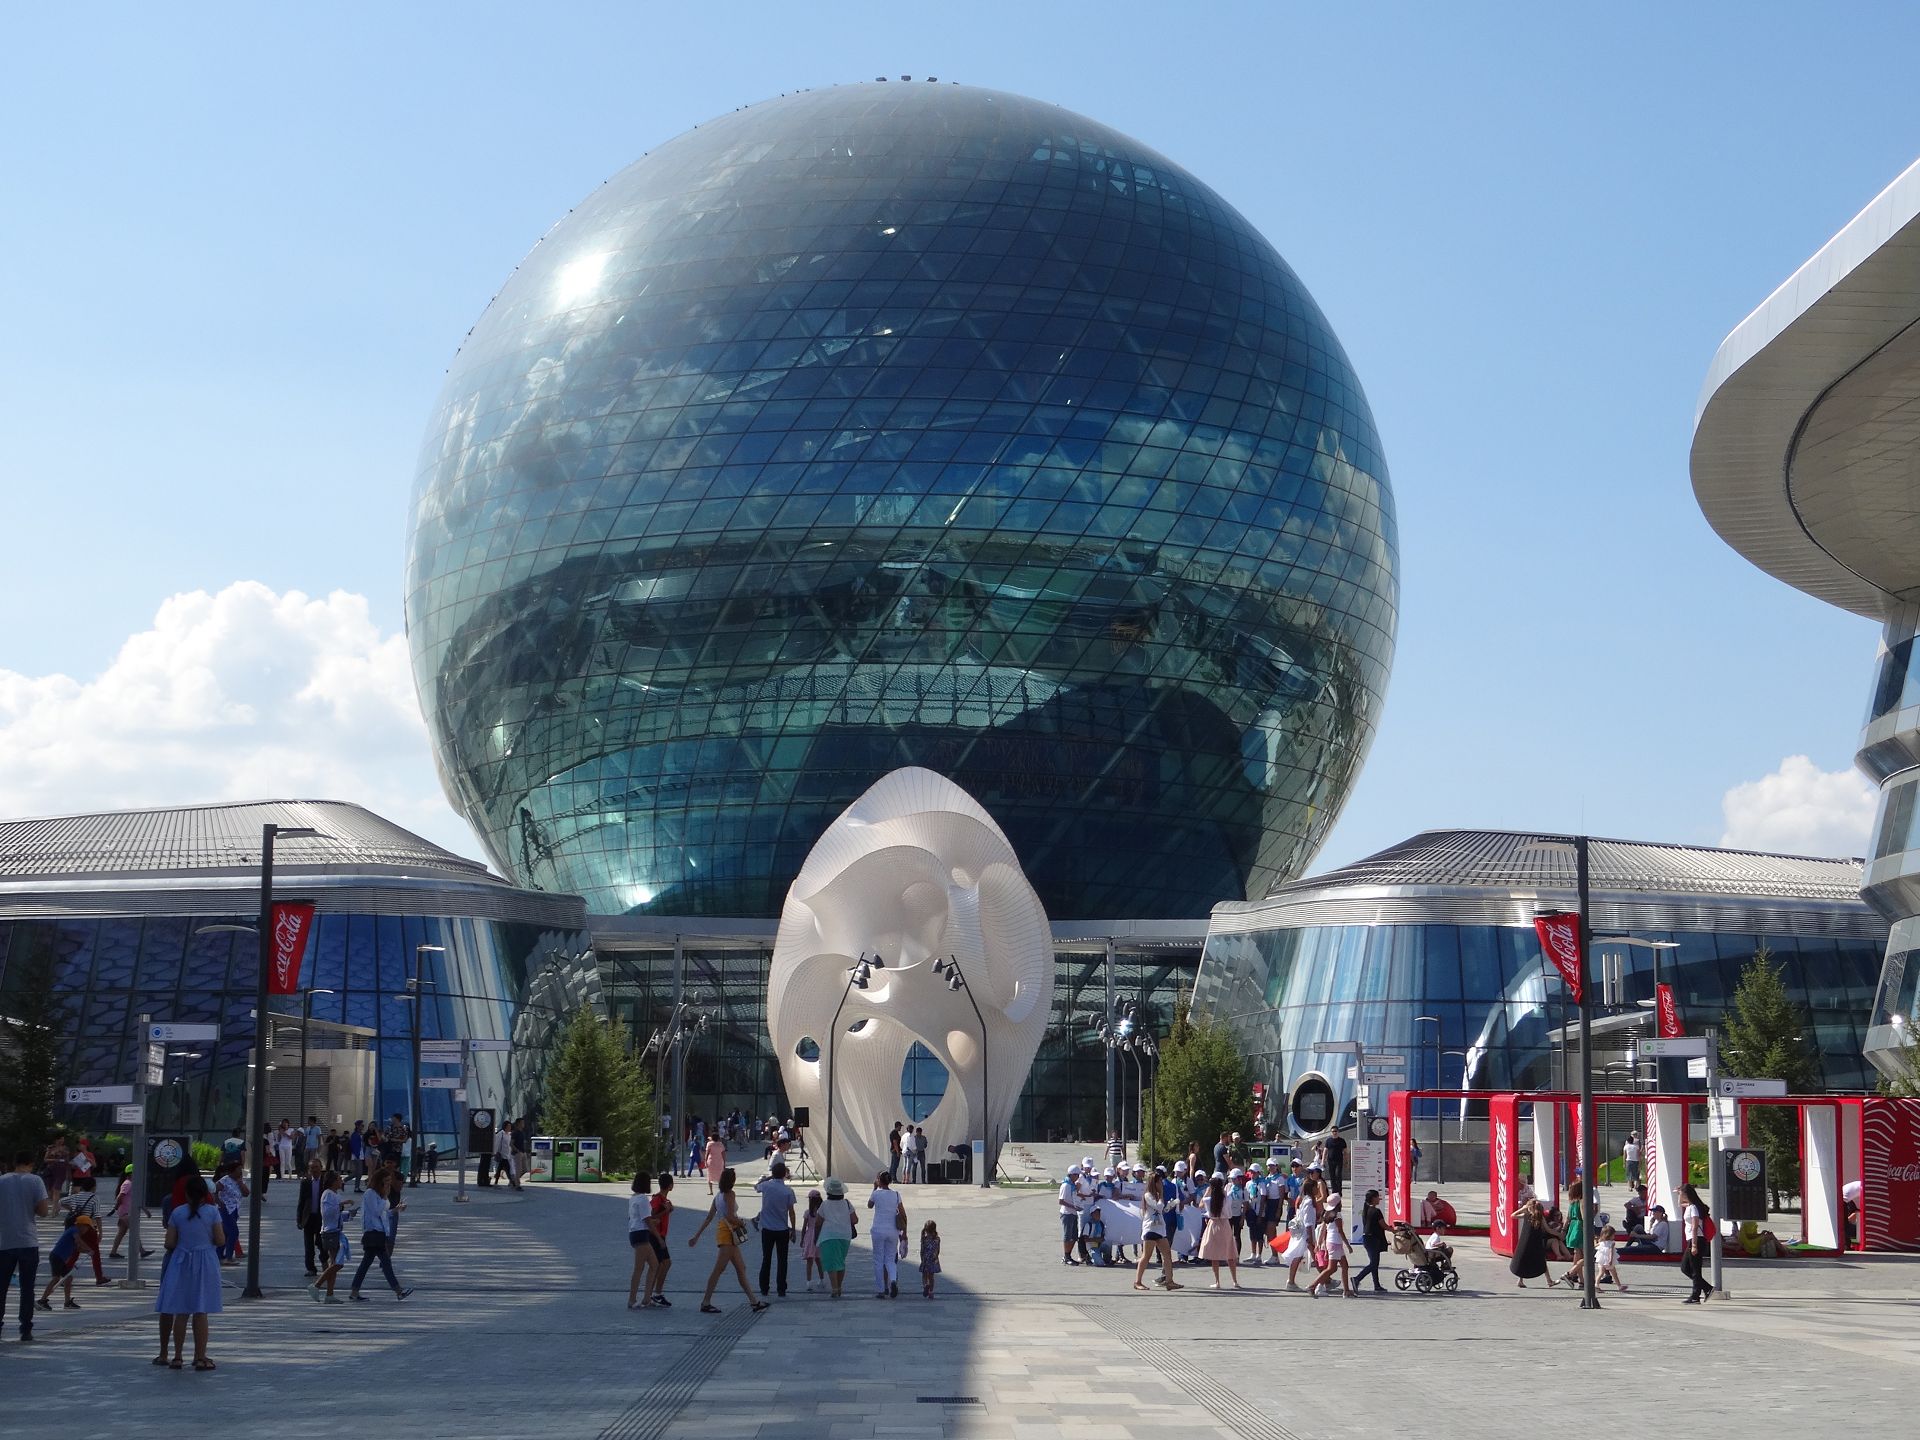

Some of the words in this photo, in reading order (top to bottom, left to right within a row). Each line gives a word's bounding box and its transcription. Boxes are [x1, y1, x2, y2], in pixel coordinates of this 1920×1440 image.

[275, 910, 302, 989] oca-Cola
[1393, 1110, 1402, 1215] Coca-Cola
[1496, 1115, 1507, 1237] Coca-Cola
